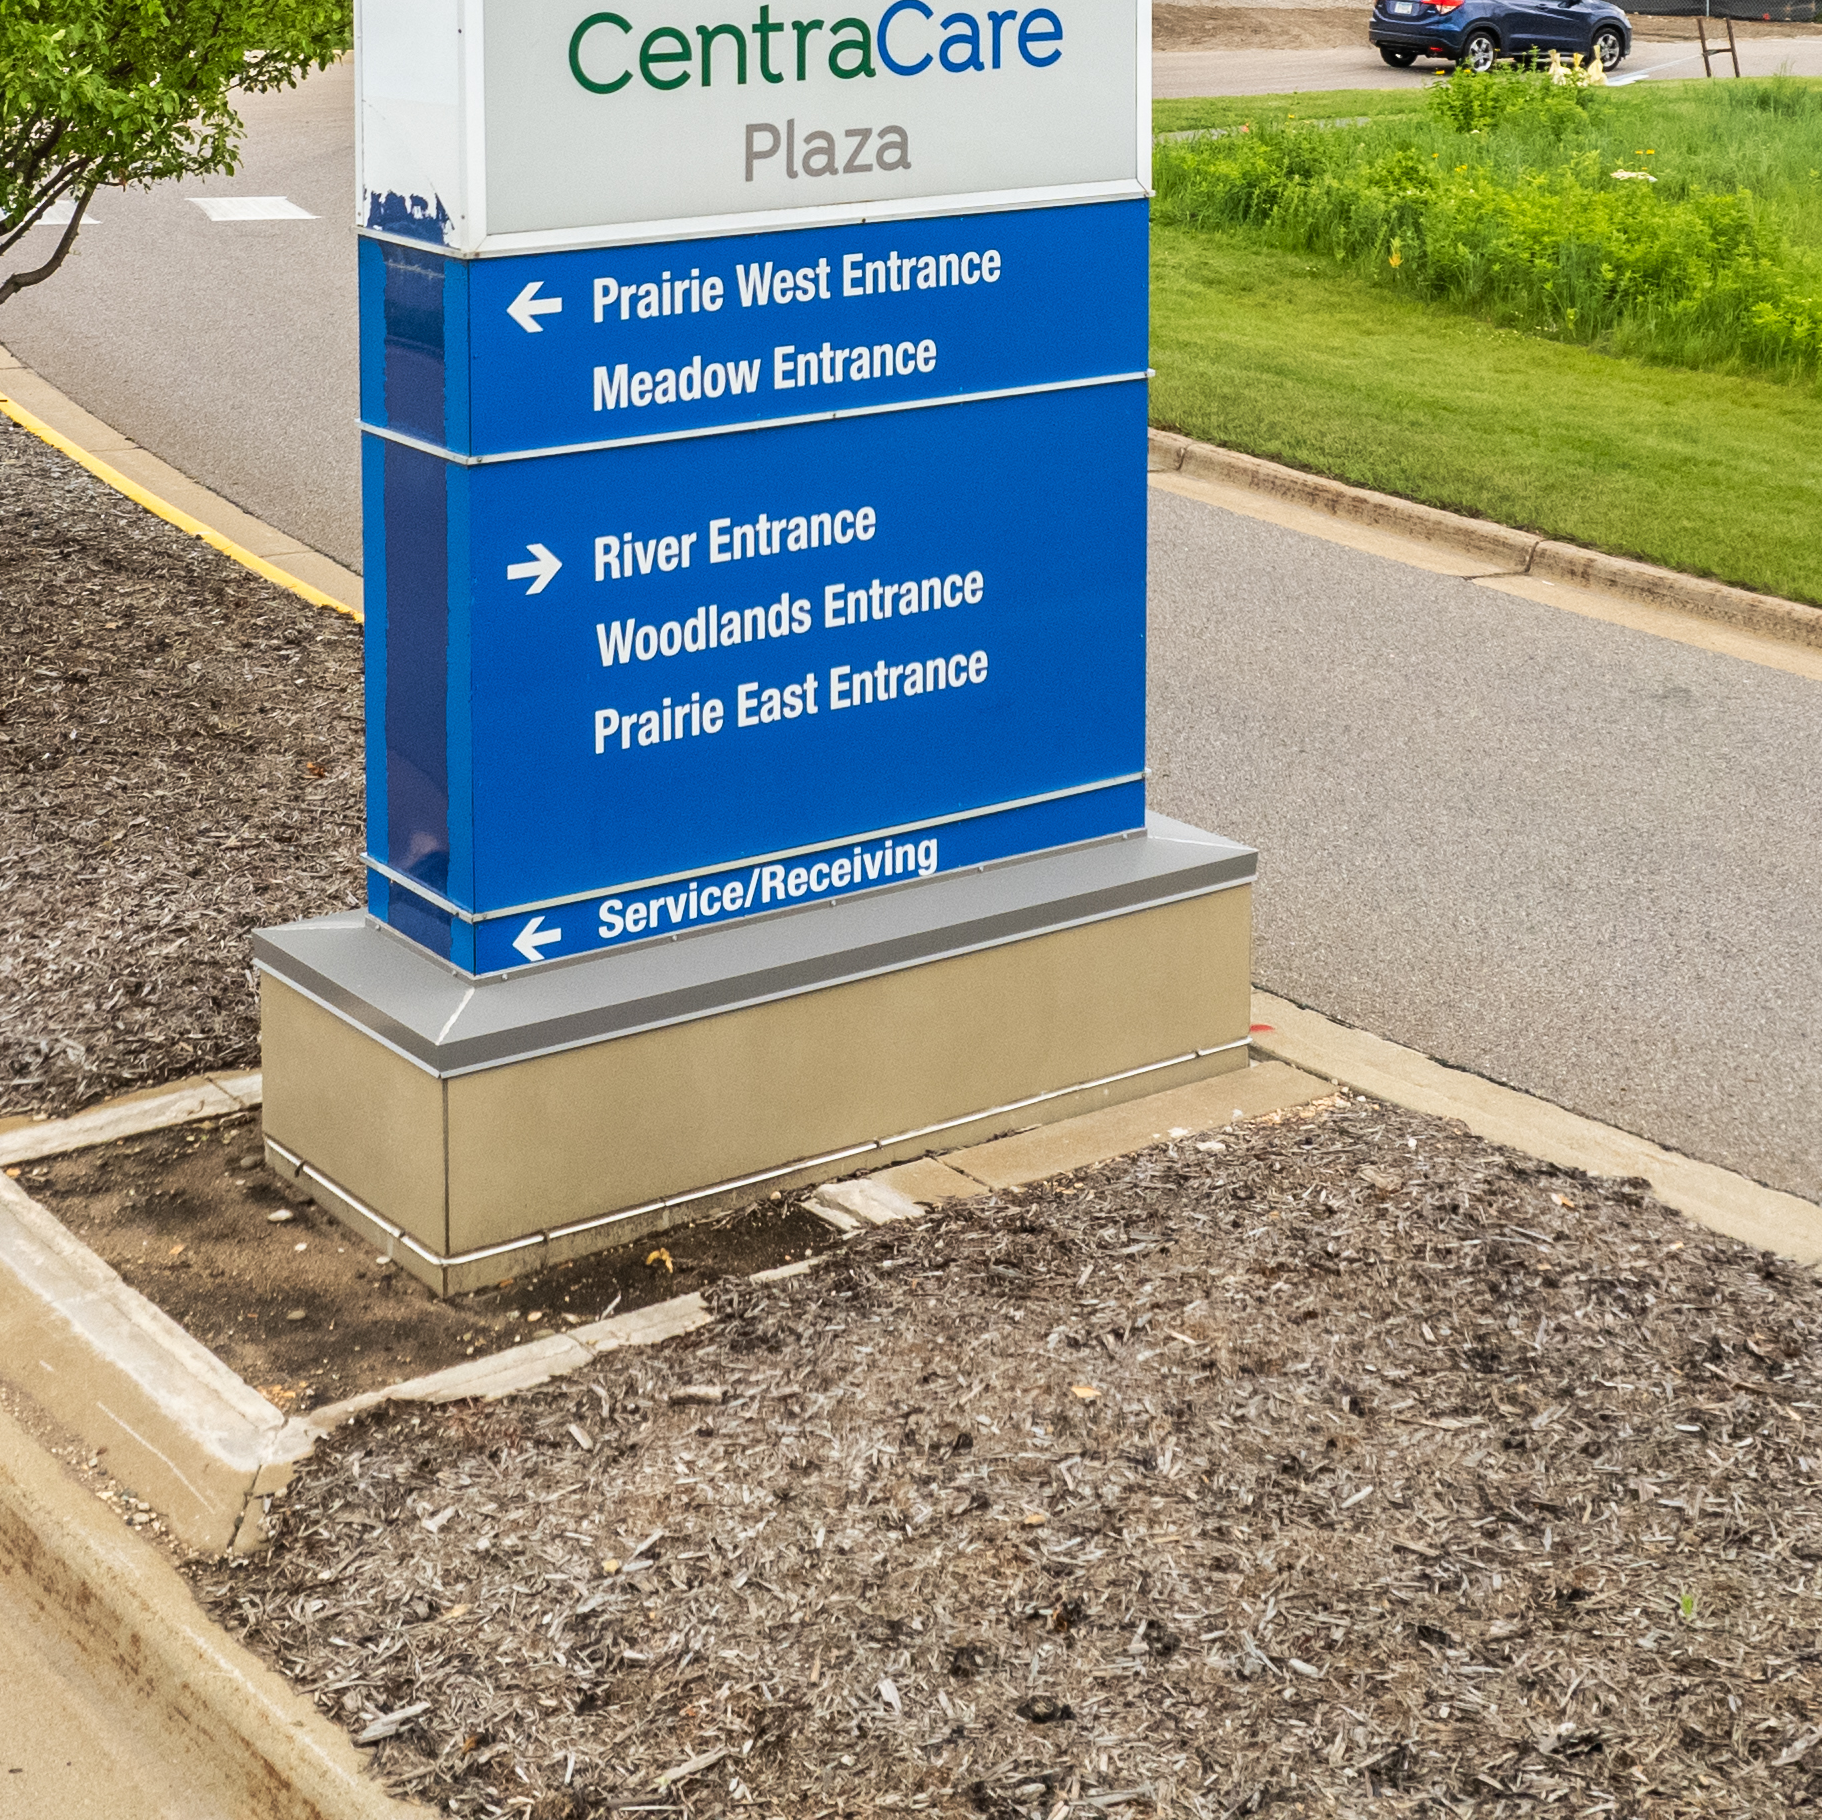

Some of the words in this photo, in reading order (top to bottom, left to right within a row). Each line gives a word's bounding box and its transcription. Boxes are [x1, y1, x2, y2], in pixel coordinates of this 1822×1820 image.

[744, 118, 912, 183] Plaza
[593, 269, 724, 323] Prairie
[735, 256, 831, 308] West
[842, 249, 1002, 297] Entrance
[593, 355, 762, 412] Meadow
[773, 338, 937, 390] Entrance
[594, 532, 697, 582] River
[709, 506, 876, 564] Entrance
[596, 592, 812, 667] Woodlands
[824, 570, 984, 629] Entrance
[594, 692, 724, 755] Prairie
[737, 672, 819, 728] East
[830, 650, 989, 710] Entrance
[598, 837, 939, 940] Service/Receiving
